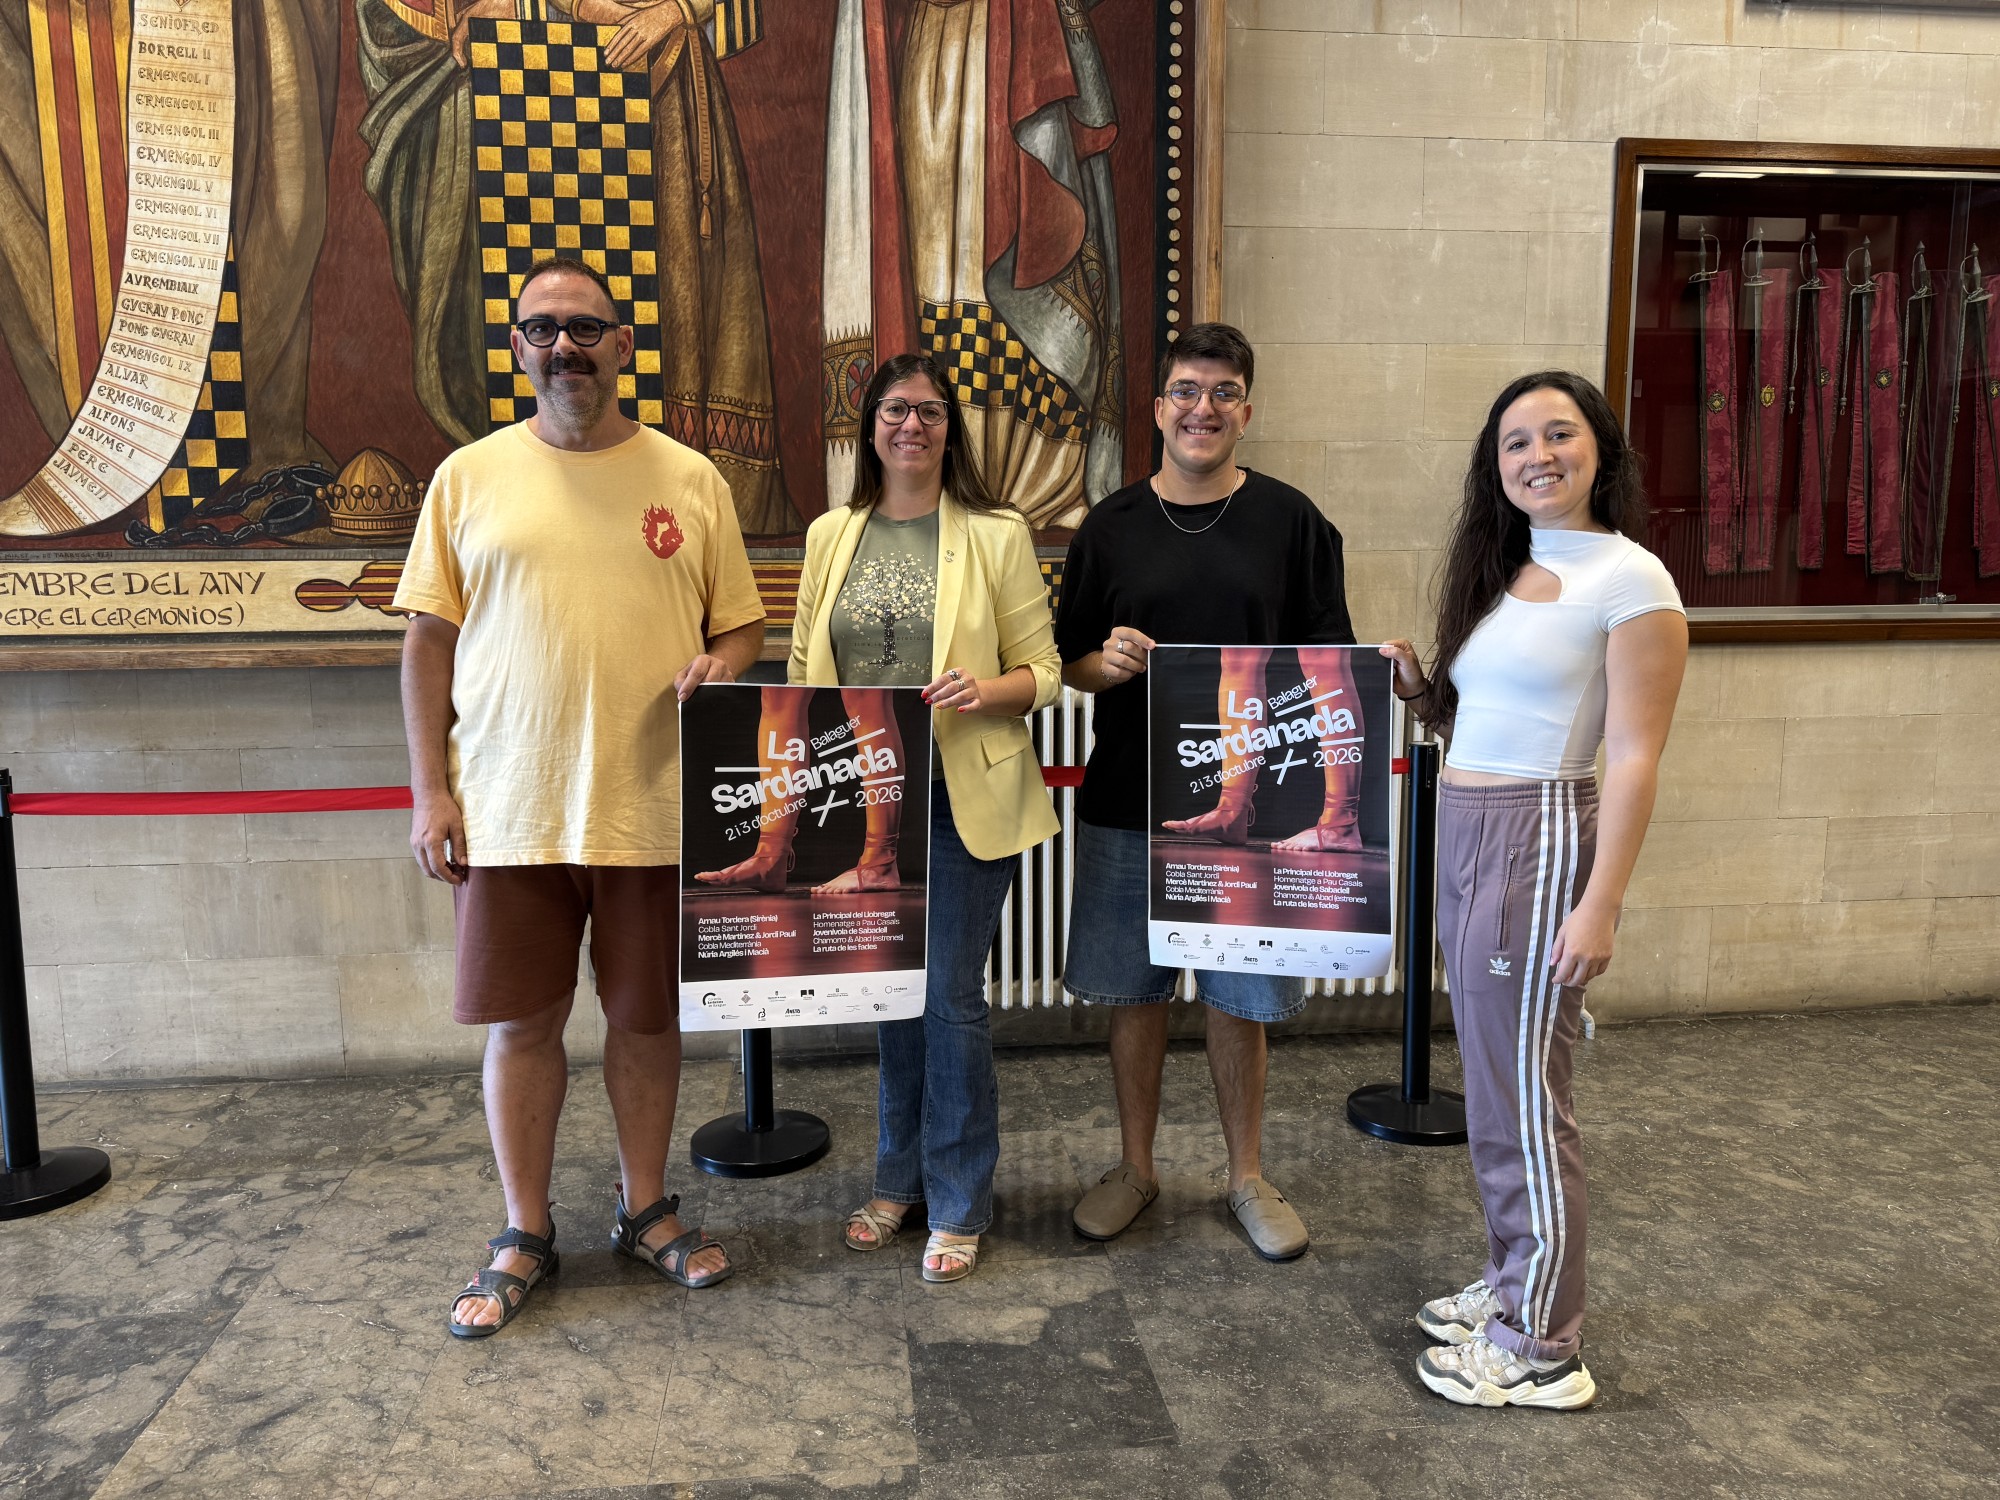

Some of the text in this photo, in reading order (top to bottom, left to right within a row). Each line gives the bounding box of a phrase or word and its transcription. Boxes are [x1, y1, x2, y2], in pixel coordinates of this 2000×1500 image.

[138, 41, 211, 60] BORRELL II
[138, 67, 210, 85] ERMENGOL I
[136, 94, 217, 113] ERMENGOL II
[136, 121, 219, 140] ERMENGOL III
[136, 146, 221, 168] ERMENGOL IV
[135, 172, 213, 192] ERMENGOL V
[135, 199, 217, 219] ERMENGOL VI
[133, 224, 219, 245] ERMENGOL VII
[131, 248, 218, 270] ERMENGOL VIII
[111, 342, 192, 372] ERMENGOL IX
[97, 385, 178, 423] ERMENGOL X
[88, 405, 136, 432] ALFONS
[68, 442, 109, 474] PERE
[128, 449, 135, 459] I
[123, 572, 189, 596] DEL
[199, 572, 265, 595] ANY
[60, 607, 86, 626] EL
[1267, 675, 1317, 710] Balaguer
[1227, 690, 1263, 721] La
[810, 715, 860, 750] Balaguer
[1177, 705, 1356, 768] Sardanada
[768, 731, 806, 762] La
[1313, 746, 1362, 768] 2026
[711, 745, 897, 813] Sardanada
[855, 785, 902, 808] 2026
[1165, 870, 1186, 878] Cobla
[1203, 872, 1220, 880] Jordi
[1273, 876, 1316, 885] Homenatge
[1322, 878, 1337, 886] Pau
[1338, 879, 1363, 887] Casals
[1282, 868, 1312, 877] Principal
[1313, 869, 1324, 877] del
[1324, 870, 1358, 879] Llobregat
[1217, 880, 1224, 888] &
[1224, 881, 1240, 889] Jordi
[1319, 886, 1350, 894] Sabadell
[1273, 891, 1307, 899] Chamorro
[1315, 894, 1333, 902] Abad
[1334, 895, 1367, 904] (estrenes)
[1298, 900, 1307, 908] de
[1307, 901, 1318, 909] les
[721, 916, 749, 924] Tordera
[813, 920, 855, 928] Homenatge
[876, 918, 900, 926] Casals
[822, 912, 852, 920] Principal
[852, 911, 863, 919] del
[864, 910, 896, 919] Llobregat
[698, 924, 757, 933] Cobla Sant Jordi
[848, 927, 858, 935] de
[858, 926, 888, 935] Sabadell
[698, 943, 719, 951] Cobla
[813, 936, 847, 944] Chamorro
[837, 944, 847, 952] de
[847, 943, 857, 951] les
